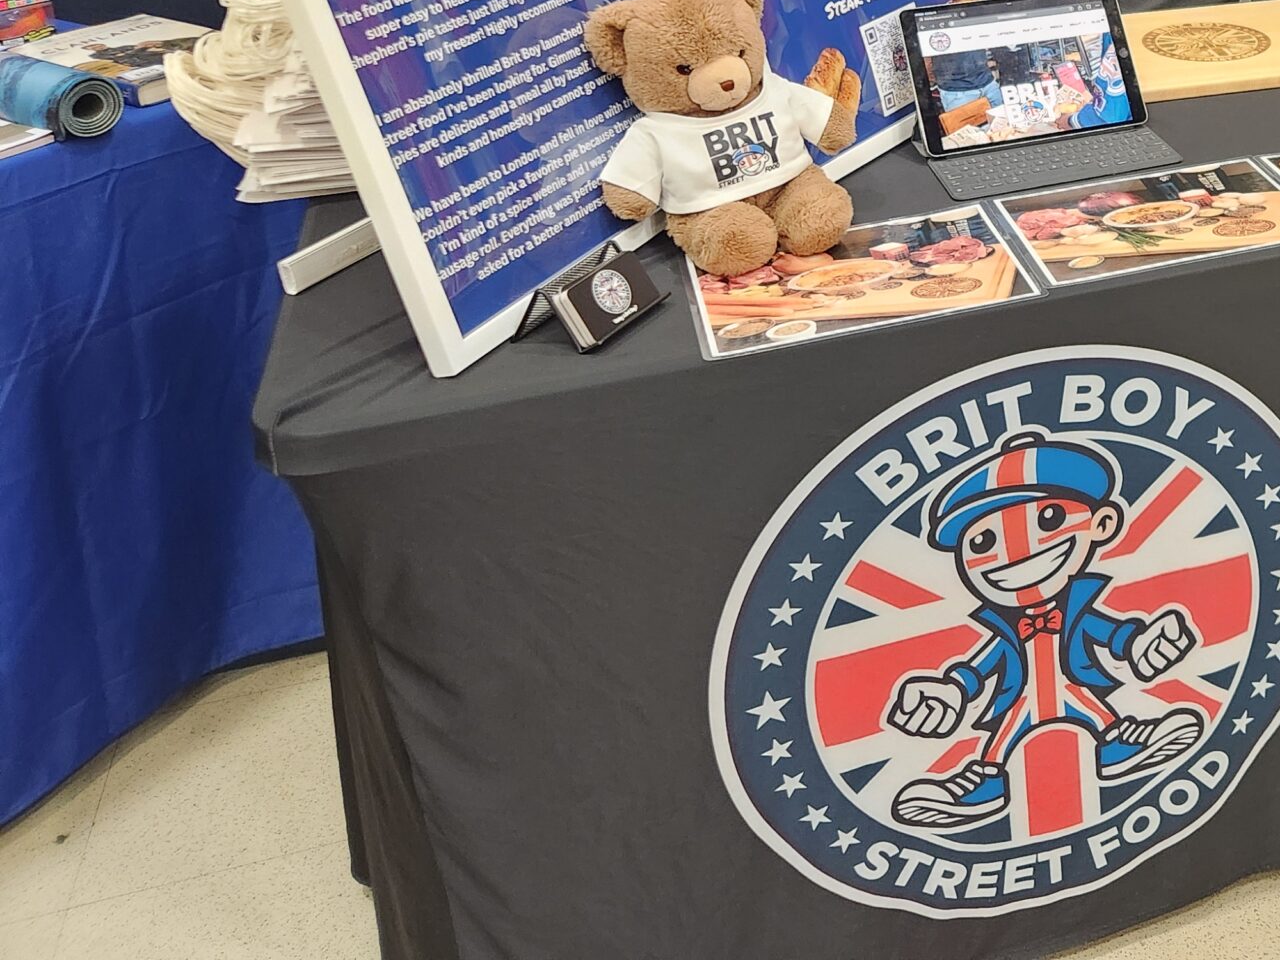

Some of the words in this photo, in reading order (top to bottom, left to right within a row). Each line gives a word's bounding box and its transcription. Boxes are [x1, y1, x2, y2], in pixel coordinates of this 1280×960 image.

[366, 19, 400, 39] super
[402, 9, 428, 25] easy
[435, 15, 469, 34] tastes
[467, 6, 489, 24] just
[488, 0, 508, 12] like
[484, 16, 517, 35] Highly
[405, 81, 462, 113] absolutely
[462, 60, 502, 86] thrilled
[540, 23, 582, 50] launched
[382, 123, 418, 147] street
[494, 70, 532, 93] looking
[548, 47, 581, 67] Gimme
[1001, 79, 1059, 105] BRIT
[439, 114, 488, 143] delicious
[489, 113, 532, 140] honestly
[552, 86, 584, 108] cannot
[702, 111, 778, 157] BRIT
[501, 149, 540, 174] London
[525, 159, 563, 183] favorite
[579, 129, 614, 153] because
[533, 178, 566, 201] weenie
[718, 175, 745, 189] STREET
[501, 207, 555, 242] Everything
[478, 254, 509, 279] asked
[532, 222, 563, 245] better
[855, 380, 1034, 507] BRIT
[1060, 374, 1216, 441] BOY
[854, 843, 1078, 901] STREET
[1089, 748, 1231, 870] FOOD
